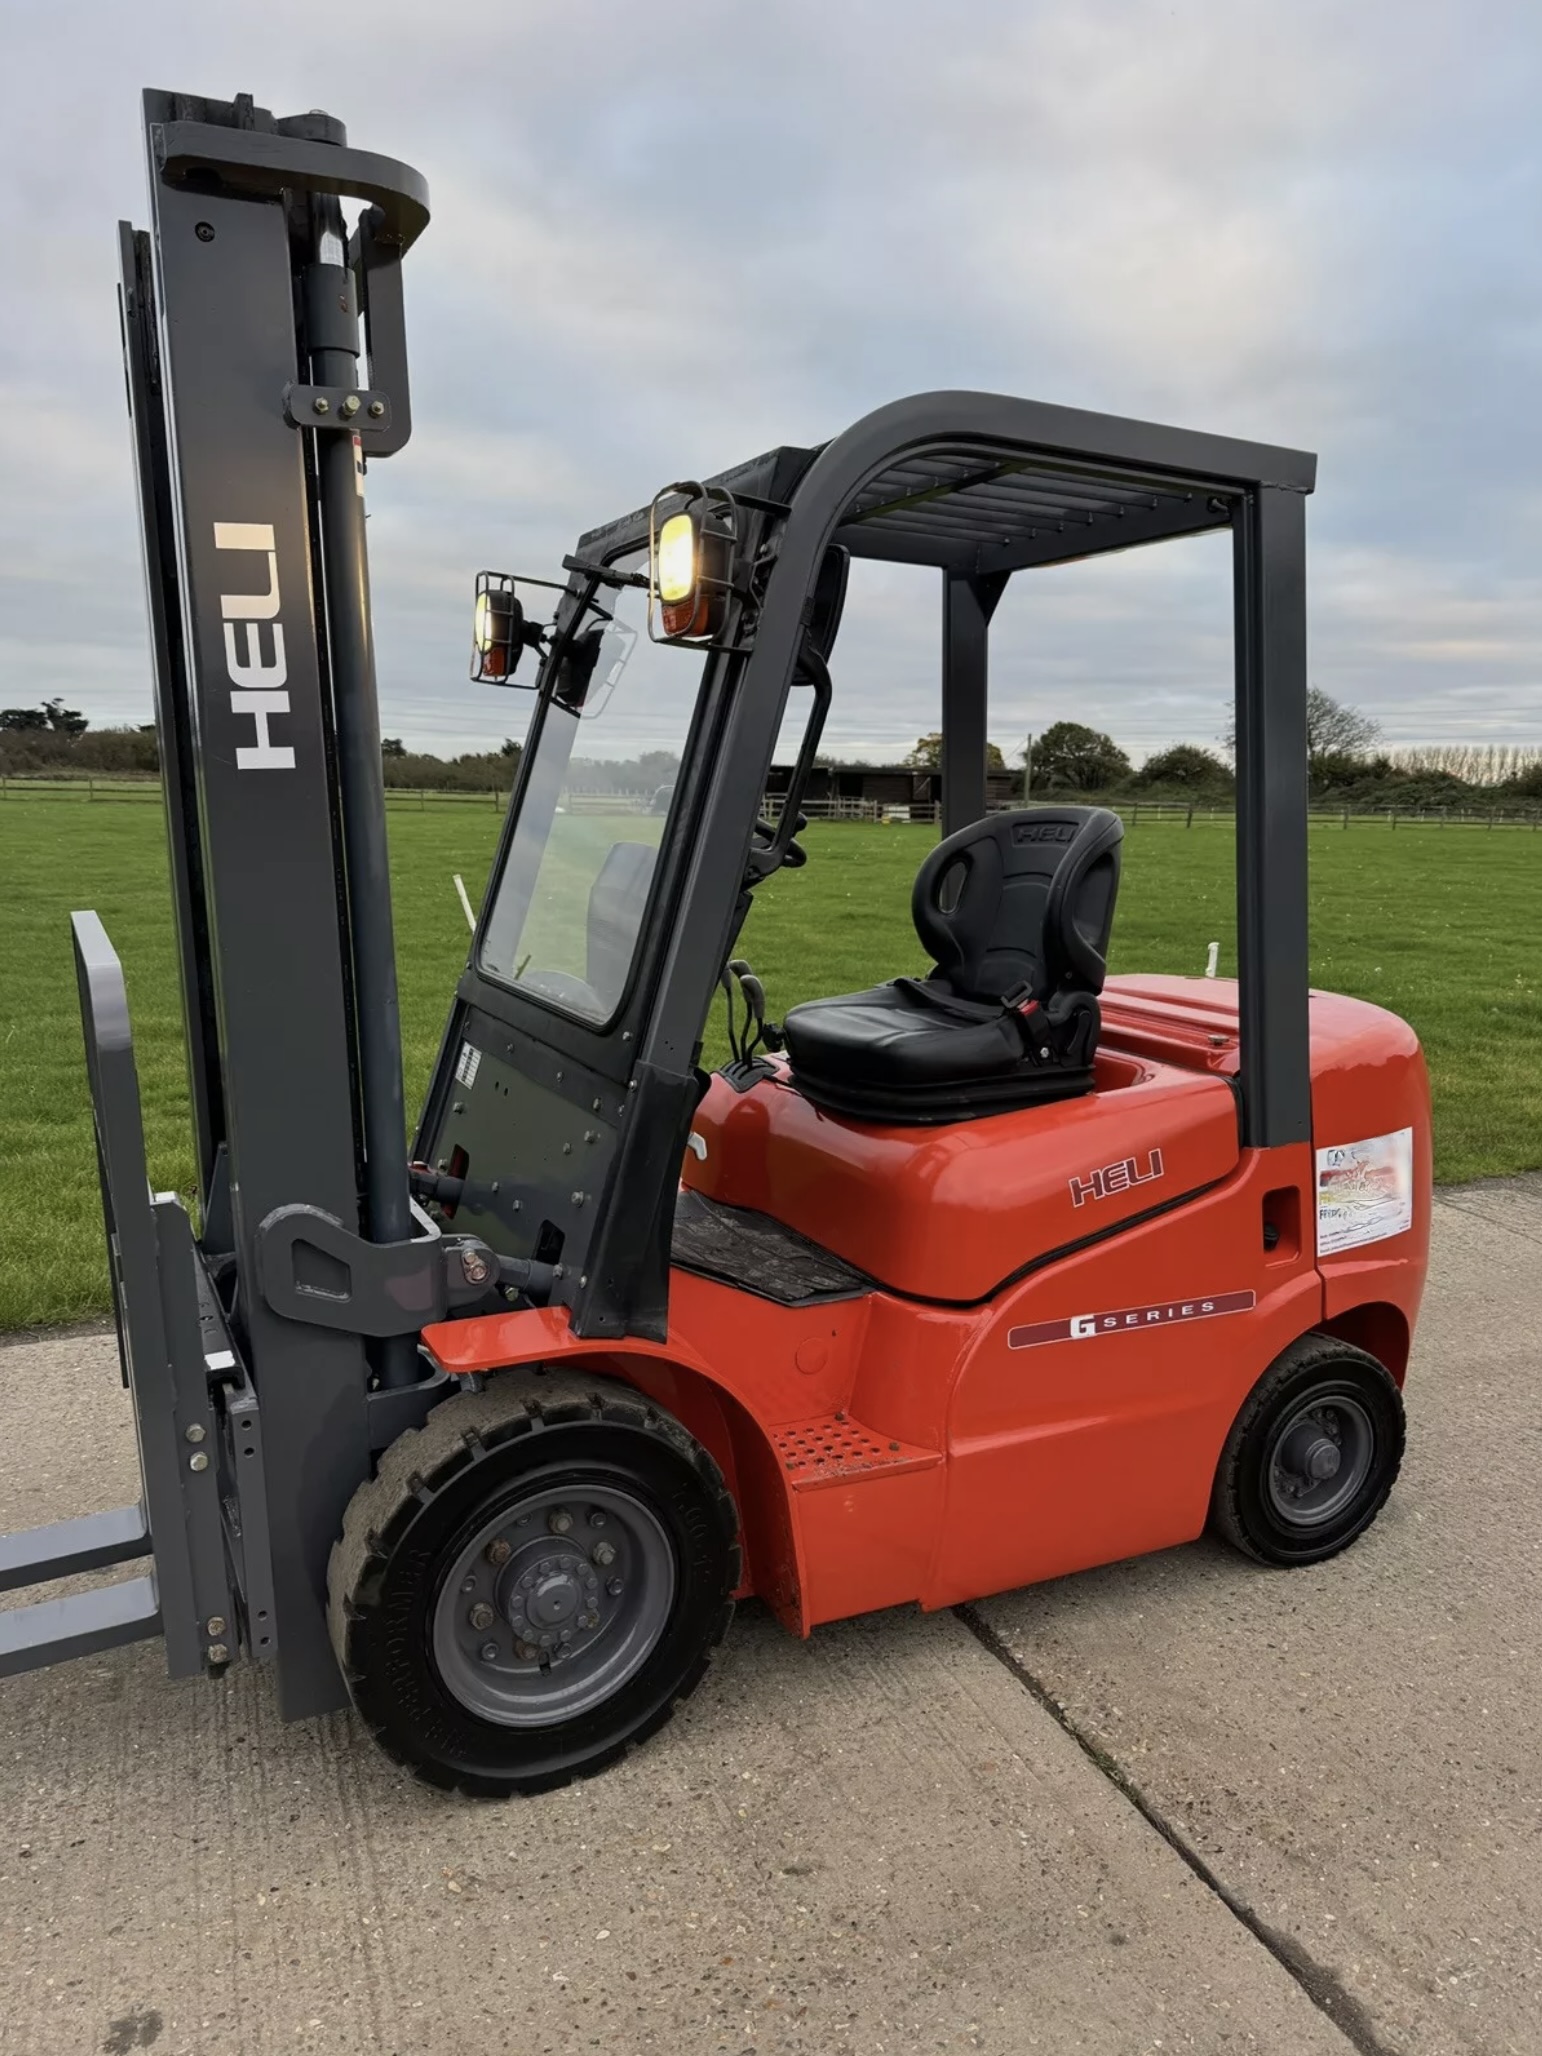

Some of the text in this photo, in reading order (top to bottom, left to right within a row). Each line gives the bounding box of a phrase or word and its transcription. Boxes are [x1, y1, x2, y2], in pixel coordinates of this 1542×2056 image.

[213, 522, 296, 770] HELI
[1017, 826, 1078, 843] HELI
[1068, 1148, 1164, 1208] HELI
[1070, 1302, 1215, 1340] G SERIES
